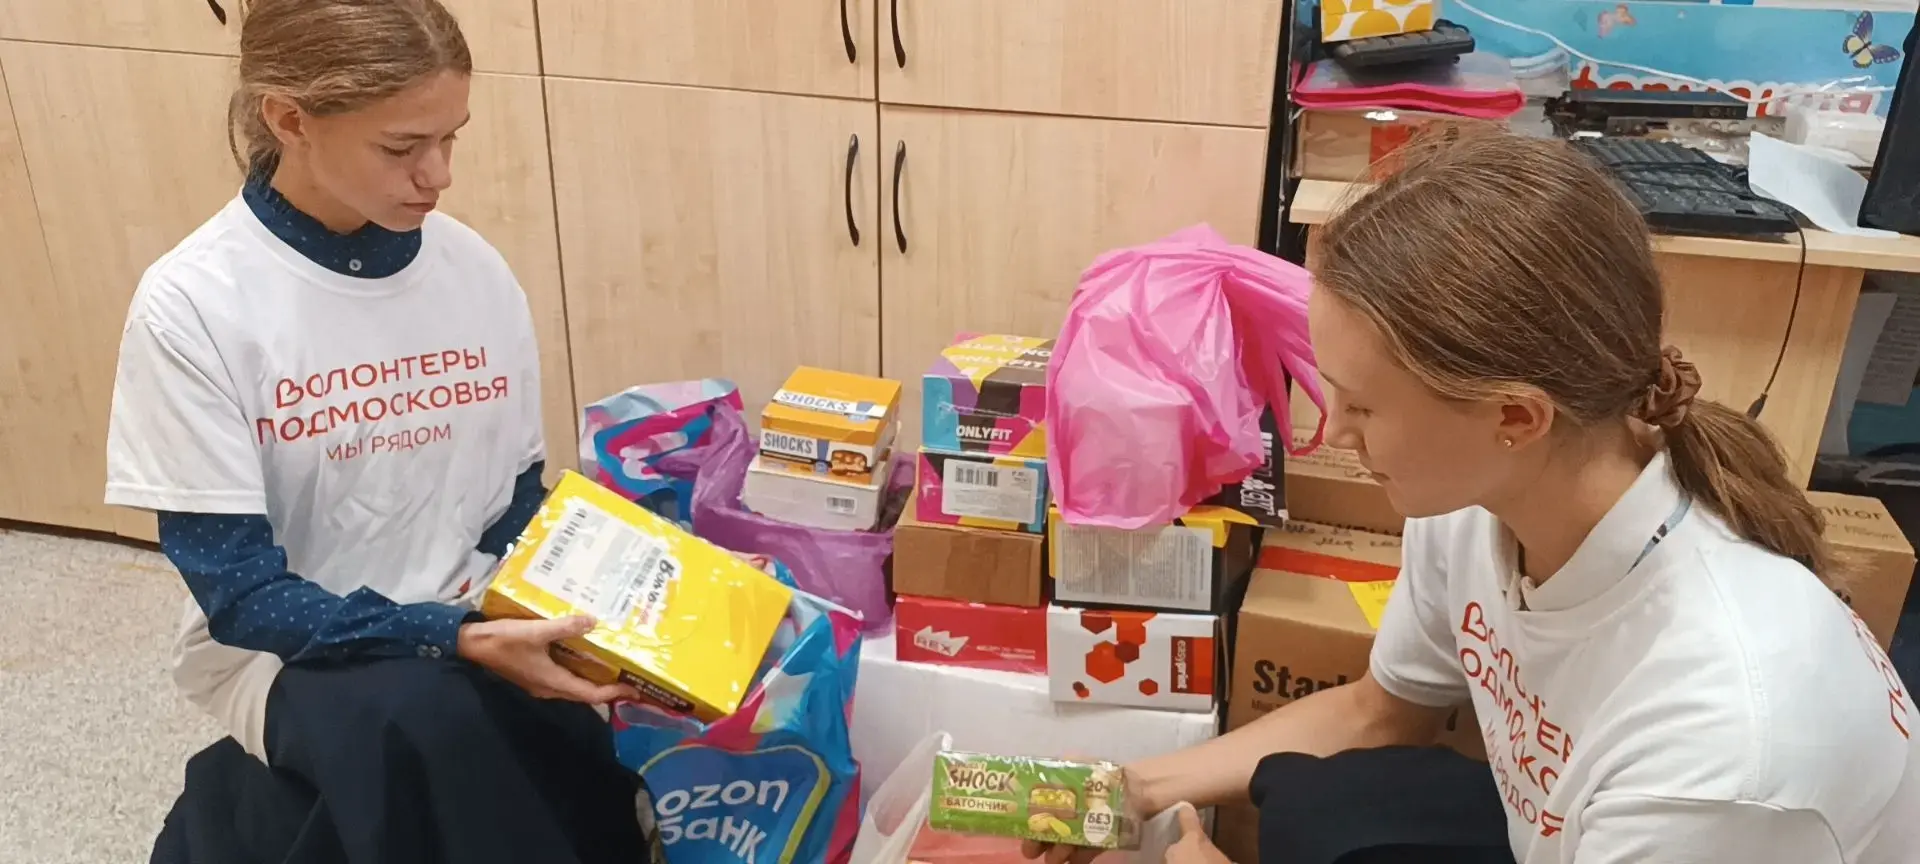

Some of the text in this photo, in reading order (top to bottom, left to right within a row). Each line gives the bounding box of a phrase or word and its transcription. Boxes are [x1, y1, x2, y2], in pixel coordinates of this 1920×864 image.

[275, 346, 487, 409] ВОЛОНТЕРЫ
[256, 375, 508, 445] ПОДМОСКОВЬЯ
[326, 423, 452, 461] МЫ РЯДОМ
[955, 424, 1013, 441] ONLYFIT
[916, 636, 952, 655] REX
[655, 779, 789, 816] ozon
[948, 769, 1017, 794] SHOCK
[1494, 755, 1538, 824] РЯДО
[945, 797, 1010, 812] БАТОНЧИК
[1087, 812, 1111, 825] БЕЗ
[656, 815, 767, 864] банк
